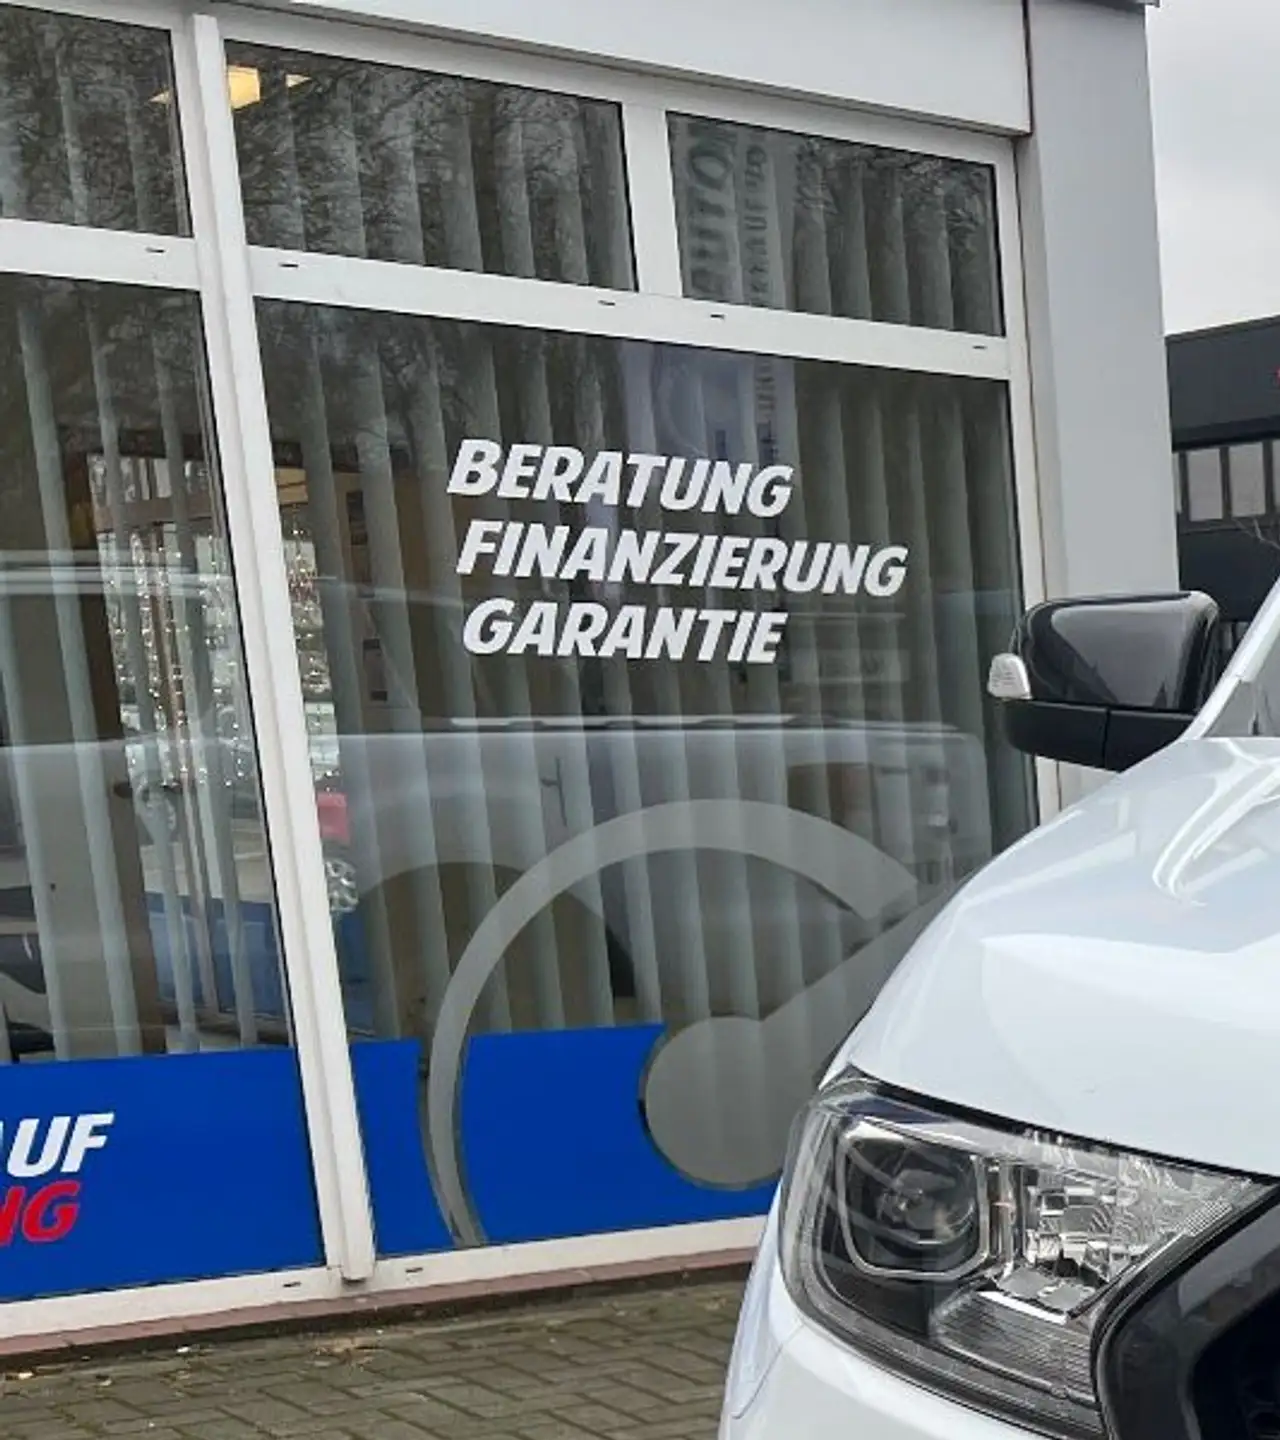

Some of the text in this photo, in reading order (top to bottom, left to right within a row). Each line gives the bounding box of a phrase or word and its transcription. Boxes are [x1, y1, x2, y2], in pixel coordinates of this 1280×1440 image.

[447, 438, 794, 517] BERATUNG
[456, 520, 908, 597] FINANZIERUNG
[462, 597, 788, 664] GARANTIE
[0, 1112, 115, 1177] UF
